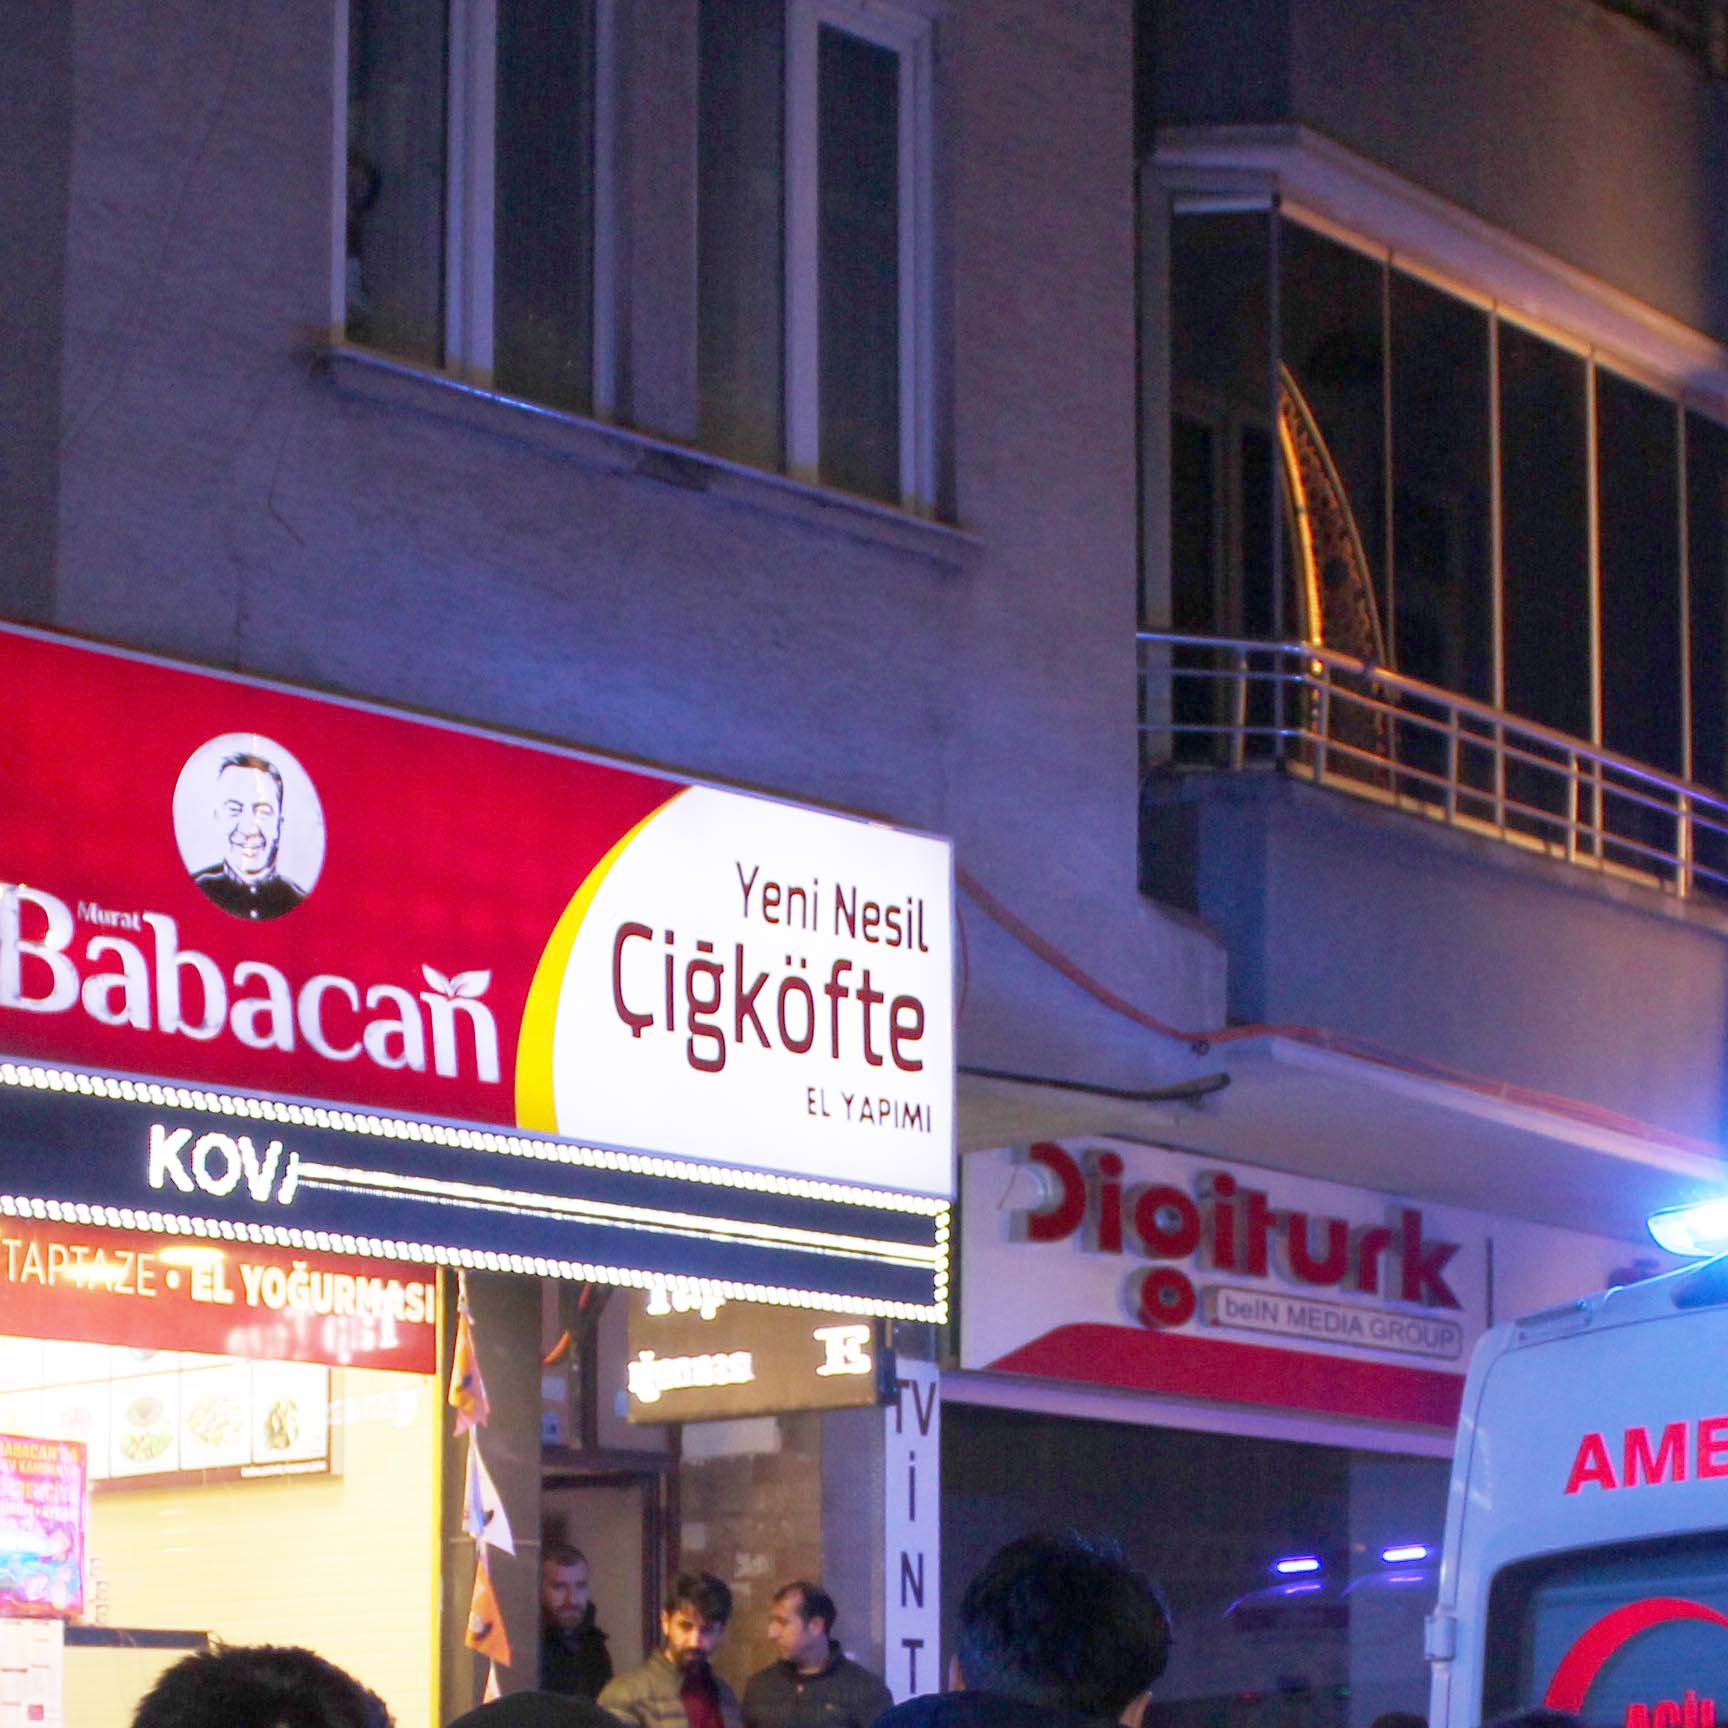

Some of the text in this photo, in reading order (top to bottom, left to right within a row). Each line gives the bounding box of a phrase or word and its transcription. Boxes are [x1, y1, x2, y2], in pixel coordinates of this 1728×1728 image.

[77, 900, 142, 933] Murat
[736, 861, 928, 953] Yeni Nesil
[612, 921, 926, 1073] Çiğköfte
[806, 1086, 931, 1133] EL YAPIMI
[1224, 1299, 1454, 1350] beIN MEDIA GROUP
